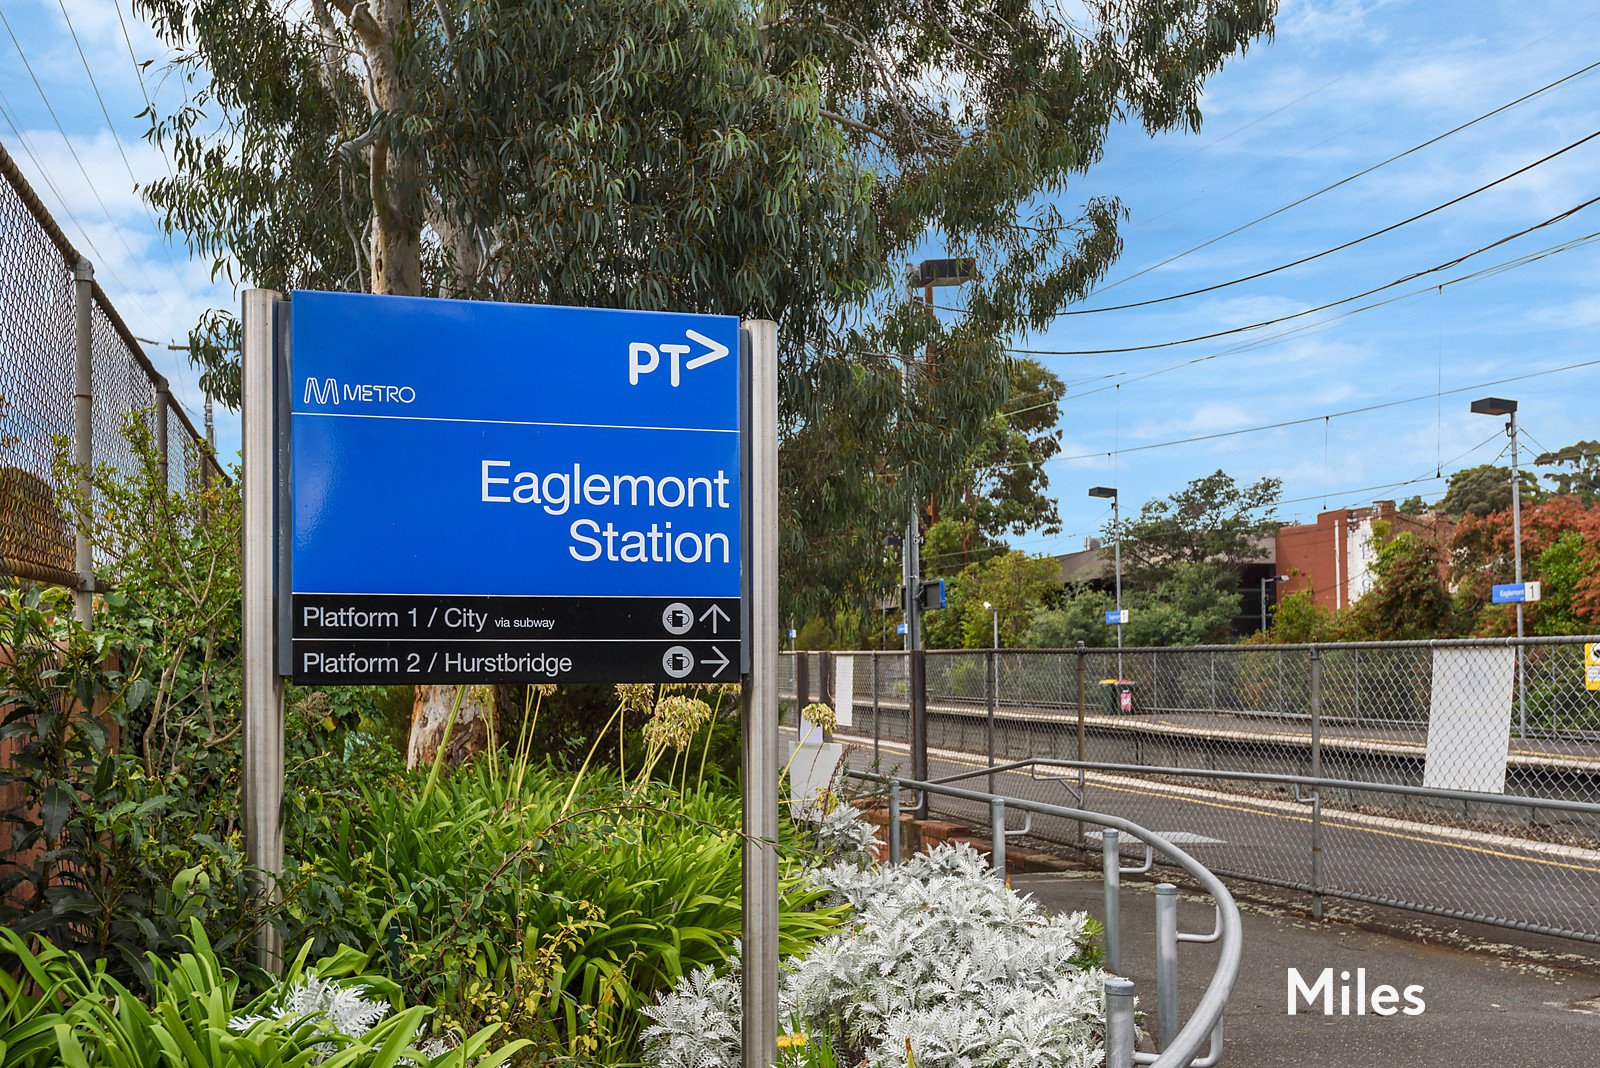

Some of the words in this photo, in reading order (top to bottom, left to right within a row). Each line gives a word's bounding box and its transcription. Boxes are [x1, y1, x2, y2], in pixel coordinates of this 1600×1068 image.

[343, 383, 416, 404] METRO
[481, 459, 730, 516] Eaglemont
[568, 518, 730, 564] Station
[303, 606, 399, 627] Platform
[407, 607, 417, 627] 1
[427, 607, 438, 628] /
[444, 607, 489, 633] City
[494, 616, 511, 628] via
[513, 615, 556, 631] subway
[303, 652, 399, 673] Platform
[406, 652, 421, 673] 2
[427, 652, 438, 673] /
[445, 652, 573, 677] Hurstbridge
